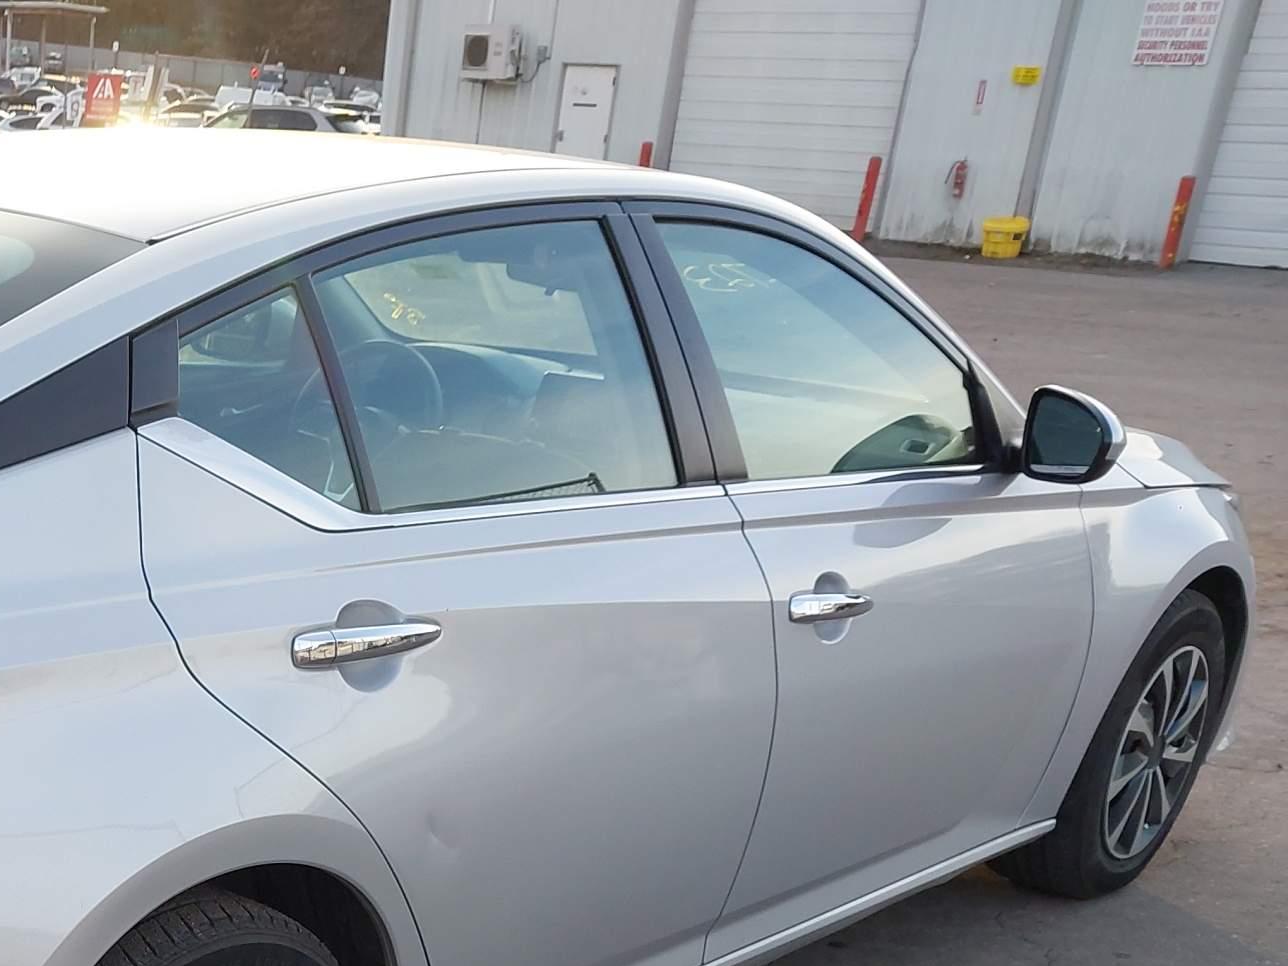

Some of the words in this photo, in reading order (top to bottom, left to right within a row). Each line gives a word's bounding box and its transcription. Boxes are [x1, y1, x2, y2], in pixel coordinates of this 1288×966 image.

[1182, 1, 1198, 12] OR
[1200, 1, 1220, 12] TRY
[1140, 27, 1189, 38] WITHOUT
[1136, 40, 1169, 50] SECURITY
[1169, 40, 1209, 50] PERSONNEL
[1133, 53, 1206, 63] AUTHORIZATION
